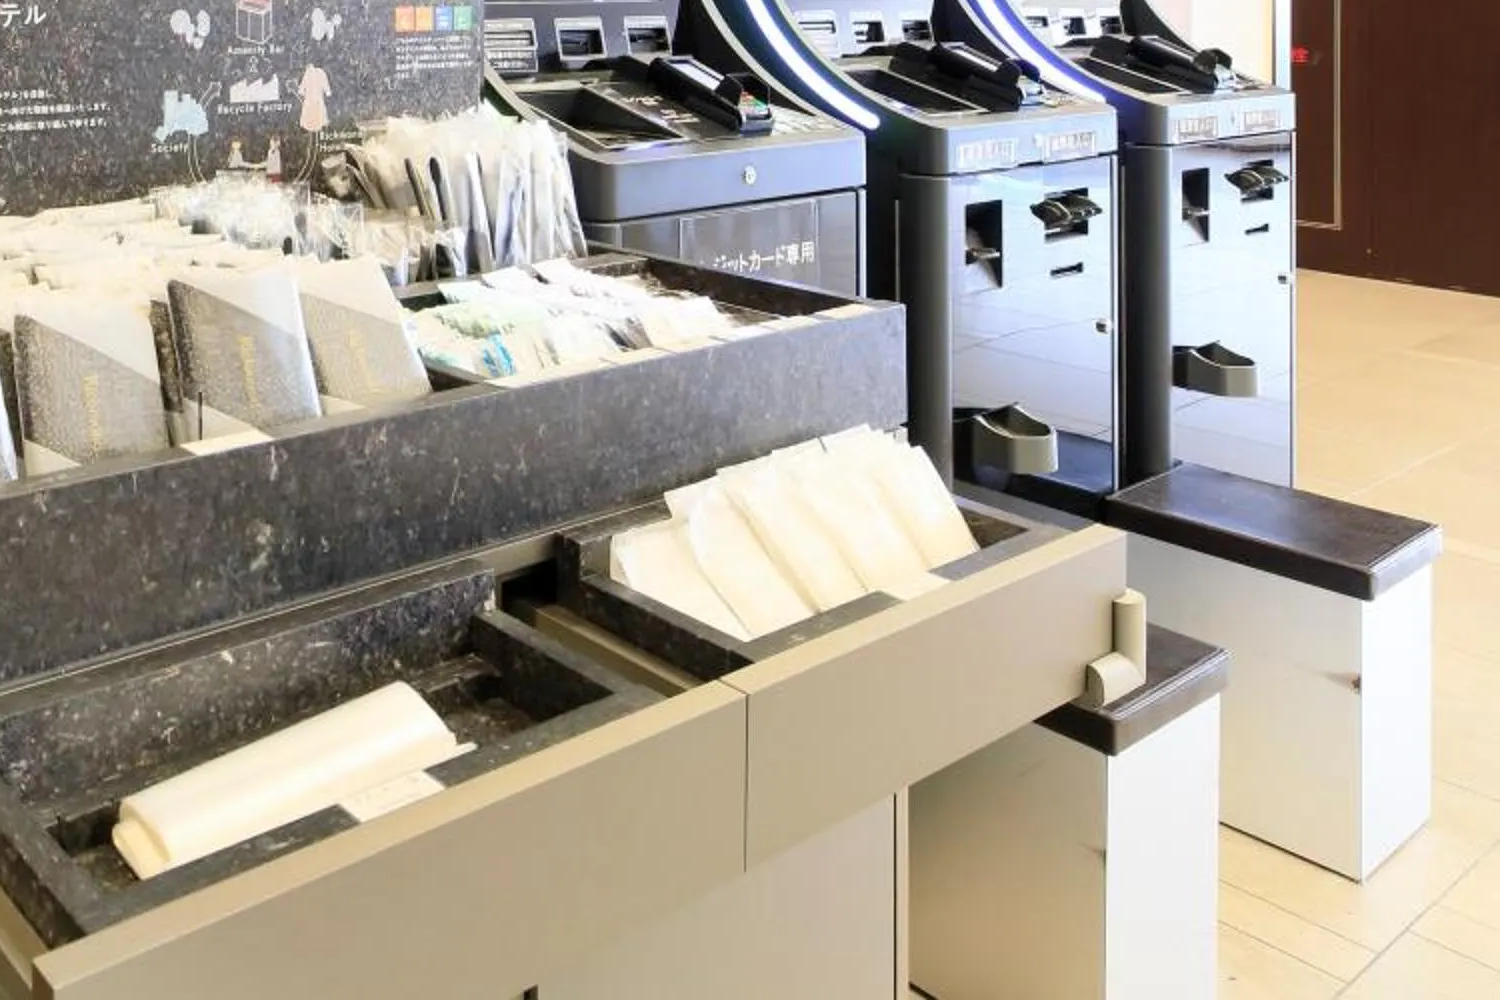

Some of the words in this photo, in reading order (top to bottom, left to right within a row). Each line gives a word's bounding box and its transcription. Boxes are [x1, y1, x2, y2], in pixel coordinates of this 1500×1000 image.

[705, 240, 815, 273] ジットカード専用
